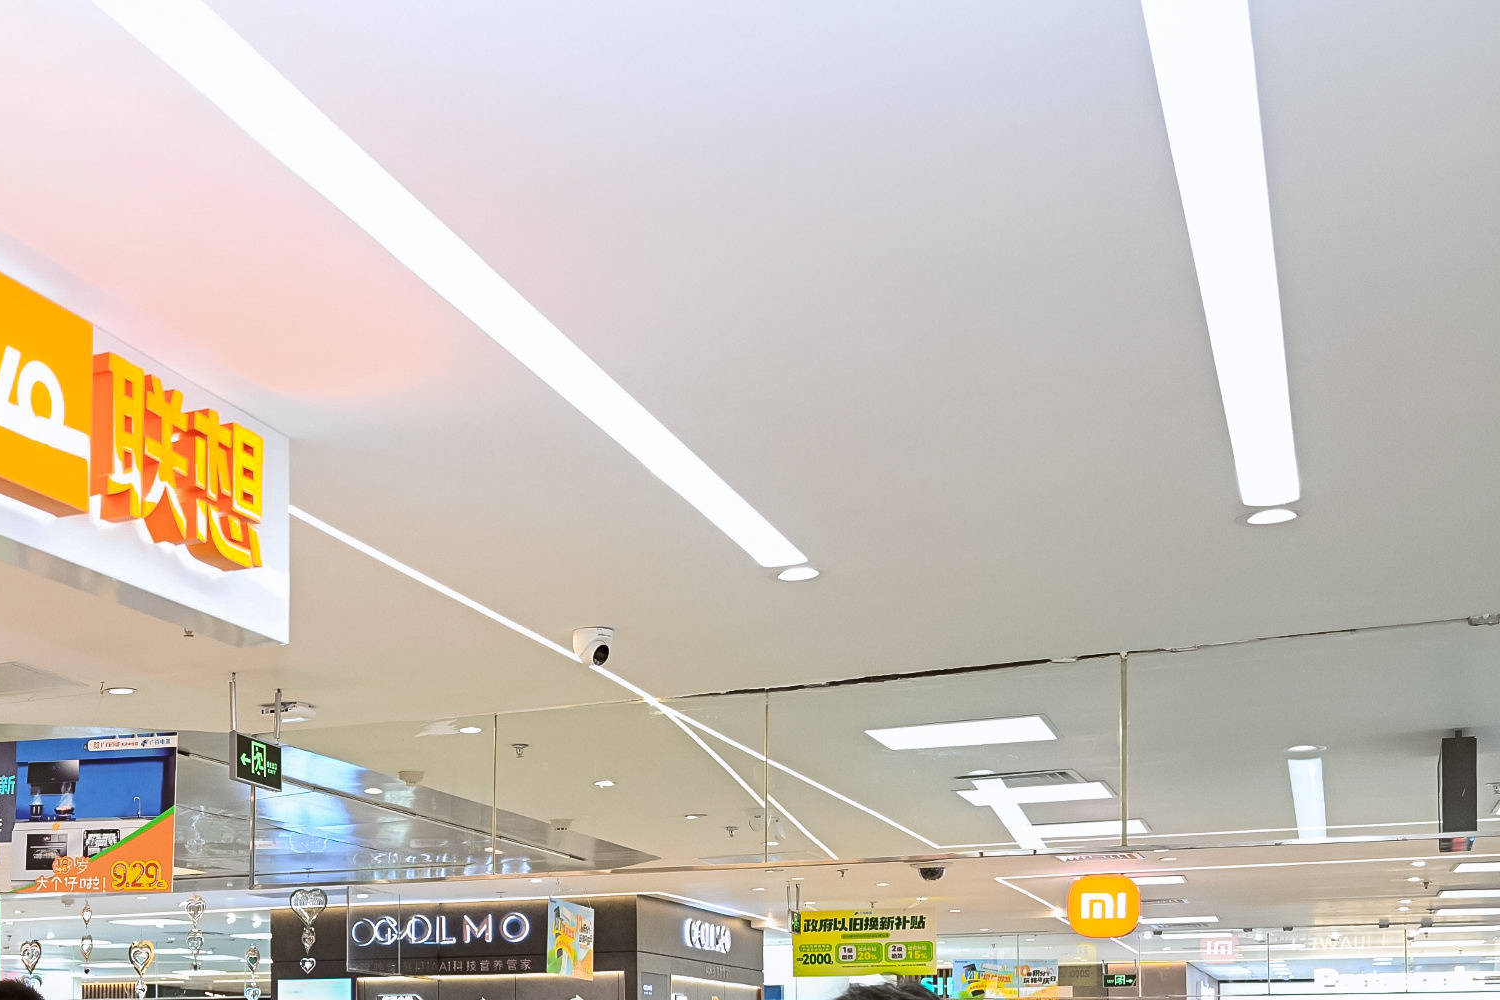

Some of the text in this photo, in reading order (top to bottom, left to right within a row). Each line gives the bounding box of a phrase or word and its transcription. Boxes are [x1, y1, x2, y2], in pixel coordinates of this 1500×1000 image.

[103, 352, 264, 570] 联想
[803, 915, 927, 933] 政府以旧换新补贴
[438, 958, 532, 973] AI科技营养管家
